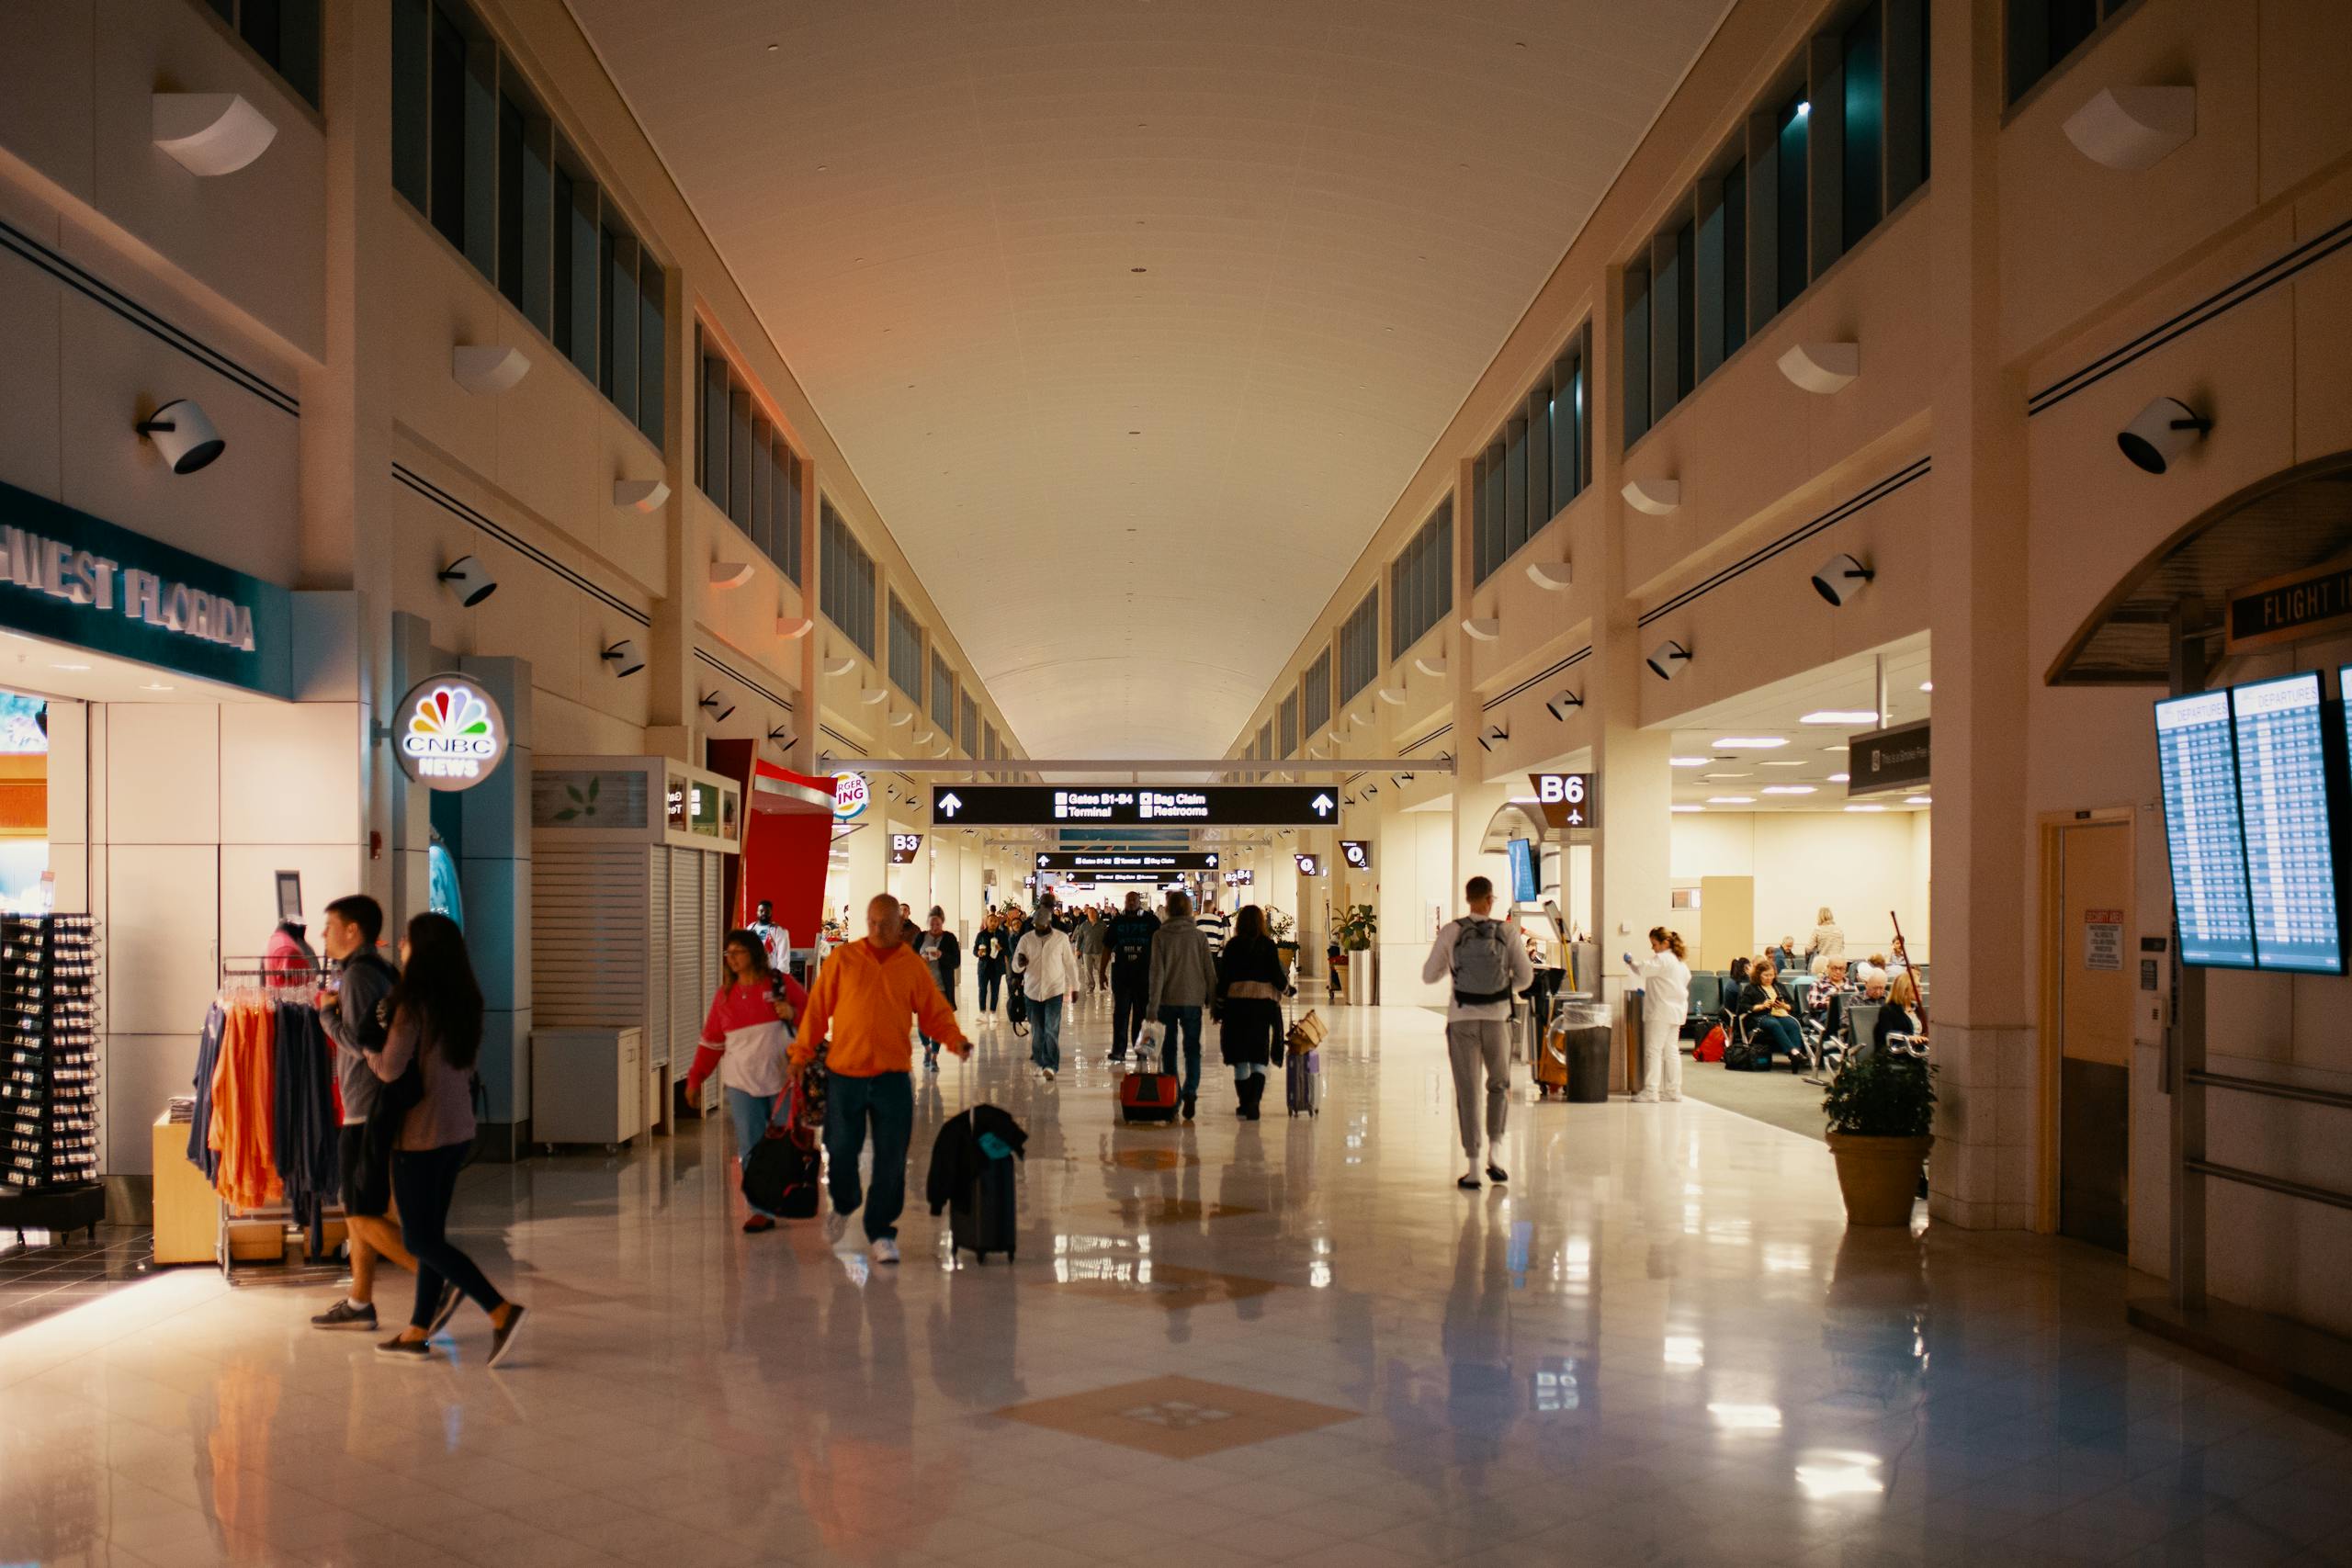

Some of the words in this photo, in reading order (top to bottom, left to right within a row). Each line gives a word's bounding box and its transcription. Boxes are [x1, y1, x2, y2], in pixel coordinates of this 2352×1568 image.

[2263, 581, 2331, 626] FLIGHT
[2339, 573, 2352, 608] I
[123, 568, 256, 651] FLORIDA
[2257, 686, 2318, 708] DEPARTURES
[2177, 701, 2228, 721] DEPARTURES
[406, 737, 491, 754] CNBC
[418, 758, 479, 778] NEWS
[838, 778, 862, 792] RGER
[1541, 775, 1584, 804] B6
[838, 787, 864, 805] ING
[1069, 794, 1100, 805] Gates
[1101, 794, 1134, 805] B1-B4
[1153, 794, 1174, 807] Bag
[1176, 794, 1206, 805] Claim
[1069, 807, 1112, 818] Terminal
[1153, 806, 1208, 817] Restrooms
[893, 835, 918, 850] B3
[1225, 874, 1238, 882] B2
[1237, 870, 1250, 879] B4
